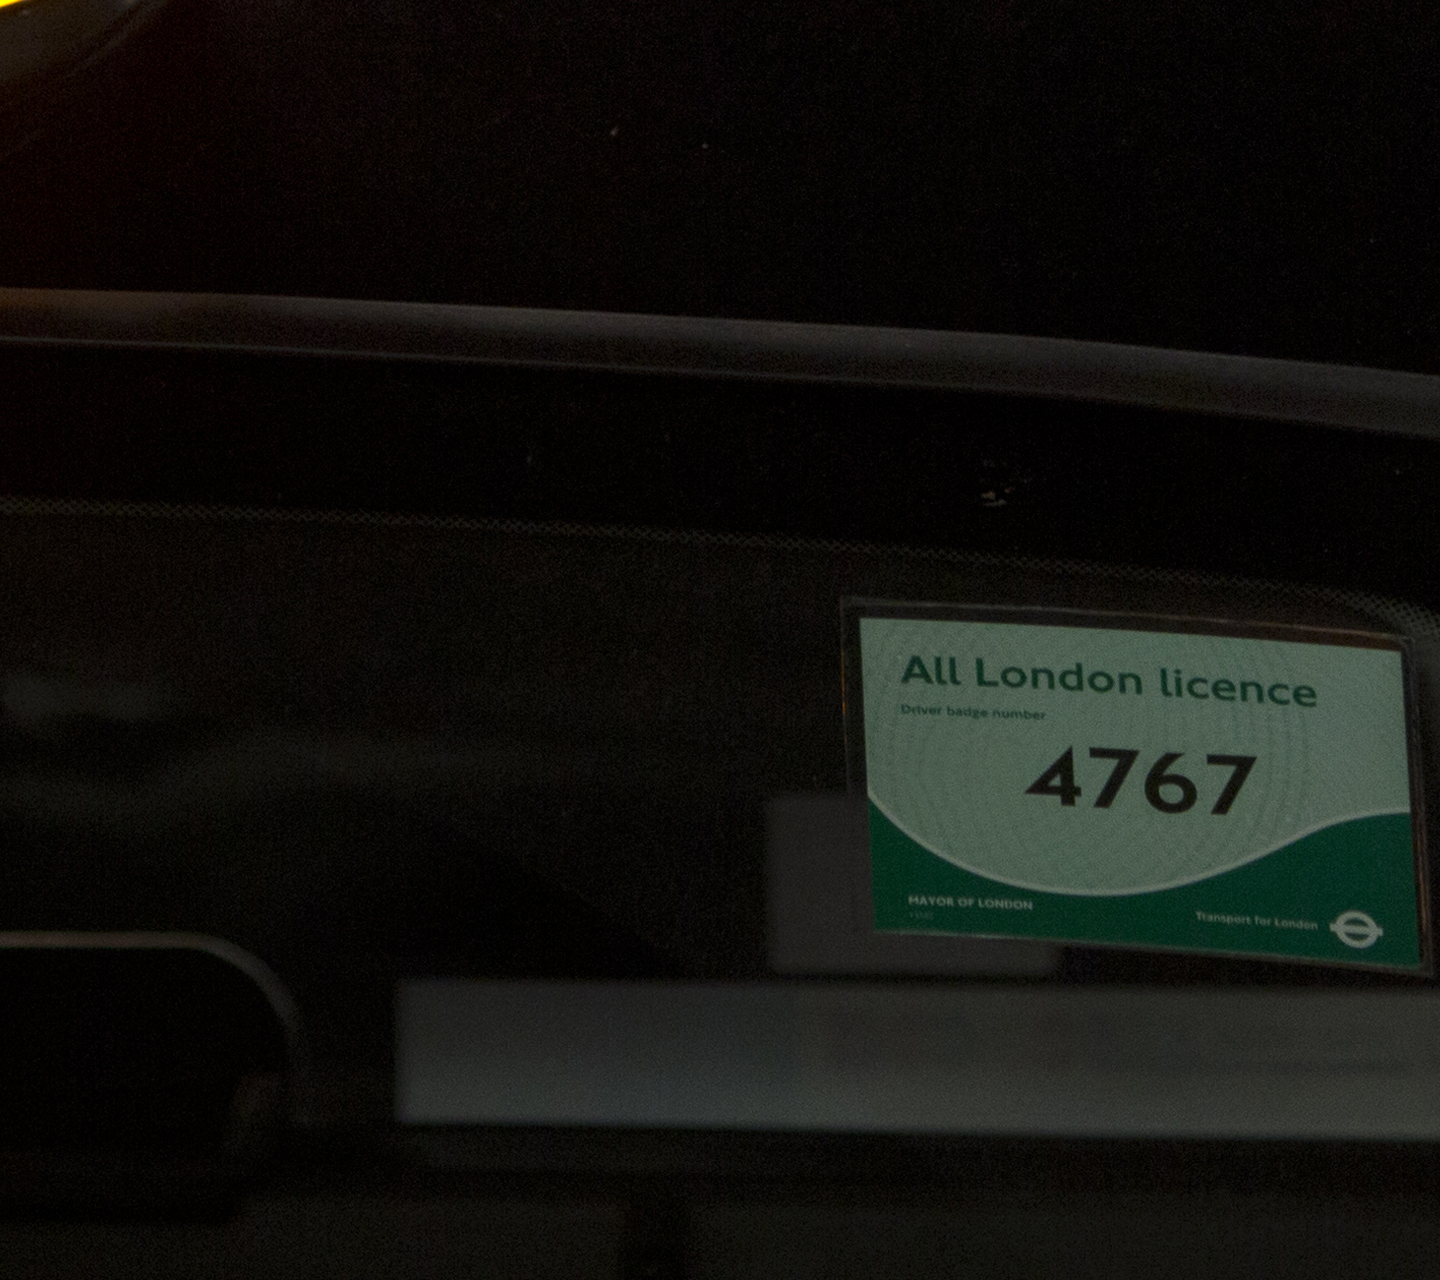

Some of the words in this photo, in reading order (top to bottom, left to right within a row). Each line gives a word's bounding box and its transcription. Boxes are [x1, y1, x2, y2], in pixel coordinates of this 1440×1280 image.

[901, 655, 960, 686] All
[976, 657, 1142, 695] London
[1160, 668, 1318, 708] licence
[901, 704, 941, 716] Driver
[947, 705, 988, 719] badge
[992, 707, 1046, 721] number
[1025, 745, 1258, 816] 4767
[908, 895, 953, 907] MAYOR
[957, 897, 975, 907] OF
[978, 898, 1033, 910] LONDON
[1195, 910, 1251, 926] Transport
[1254, 914, 1271, 927] for
[1274, 917, 1319, 930] London
